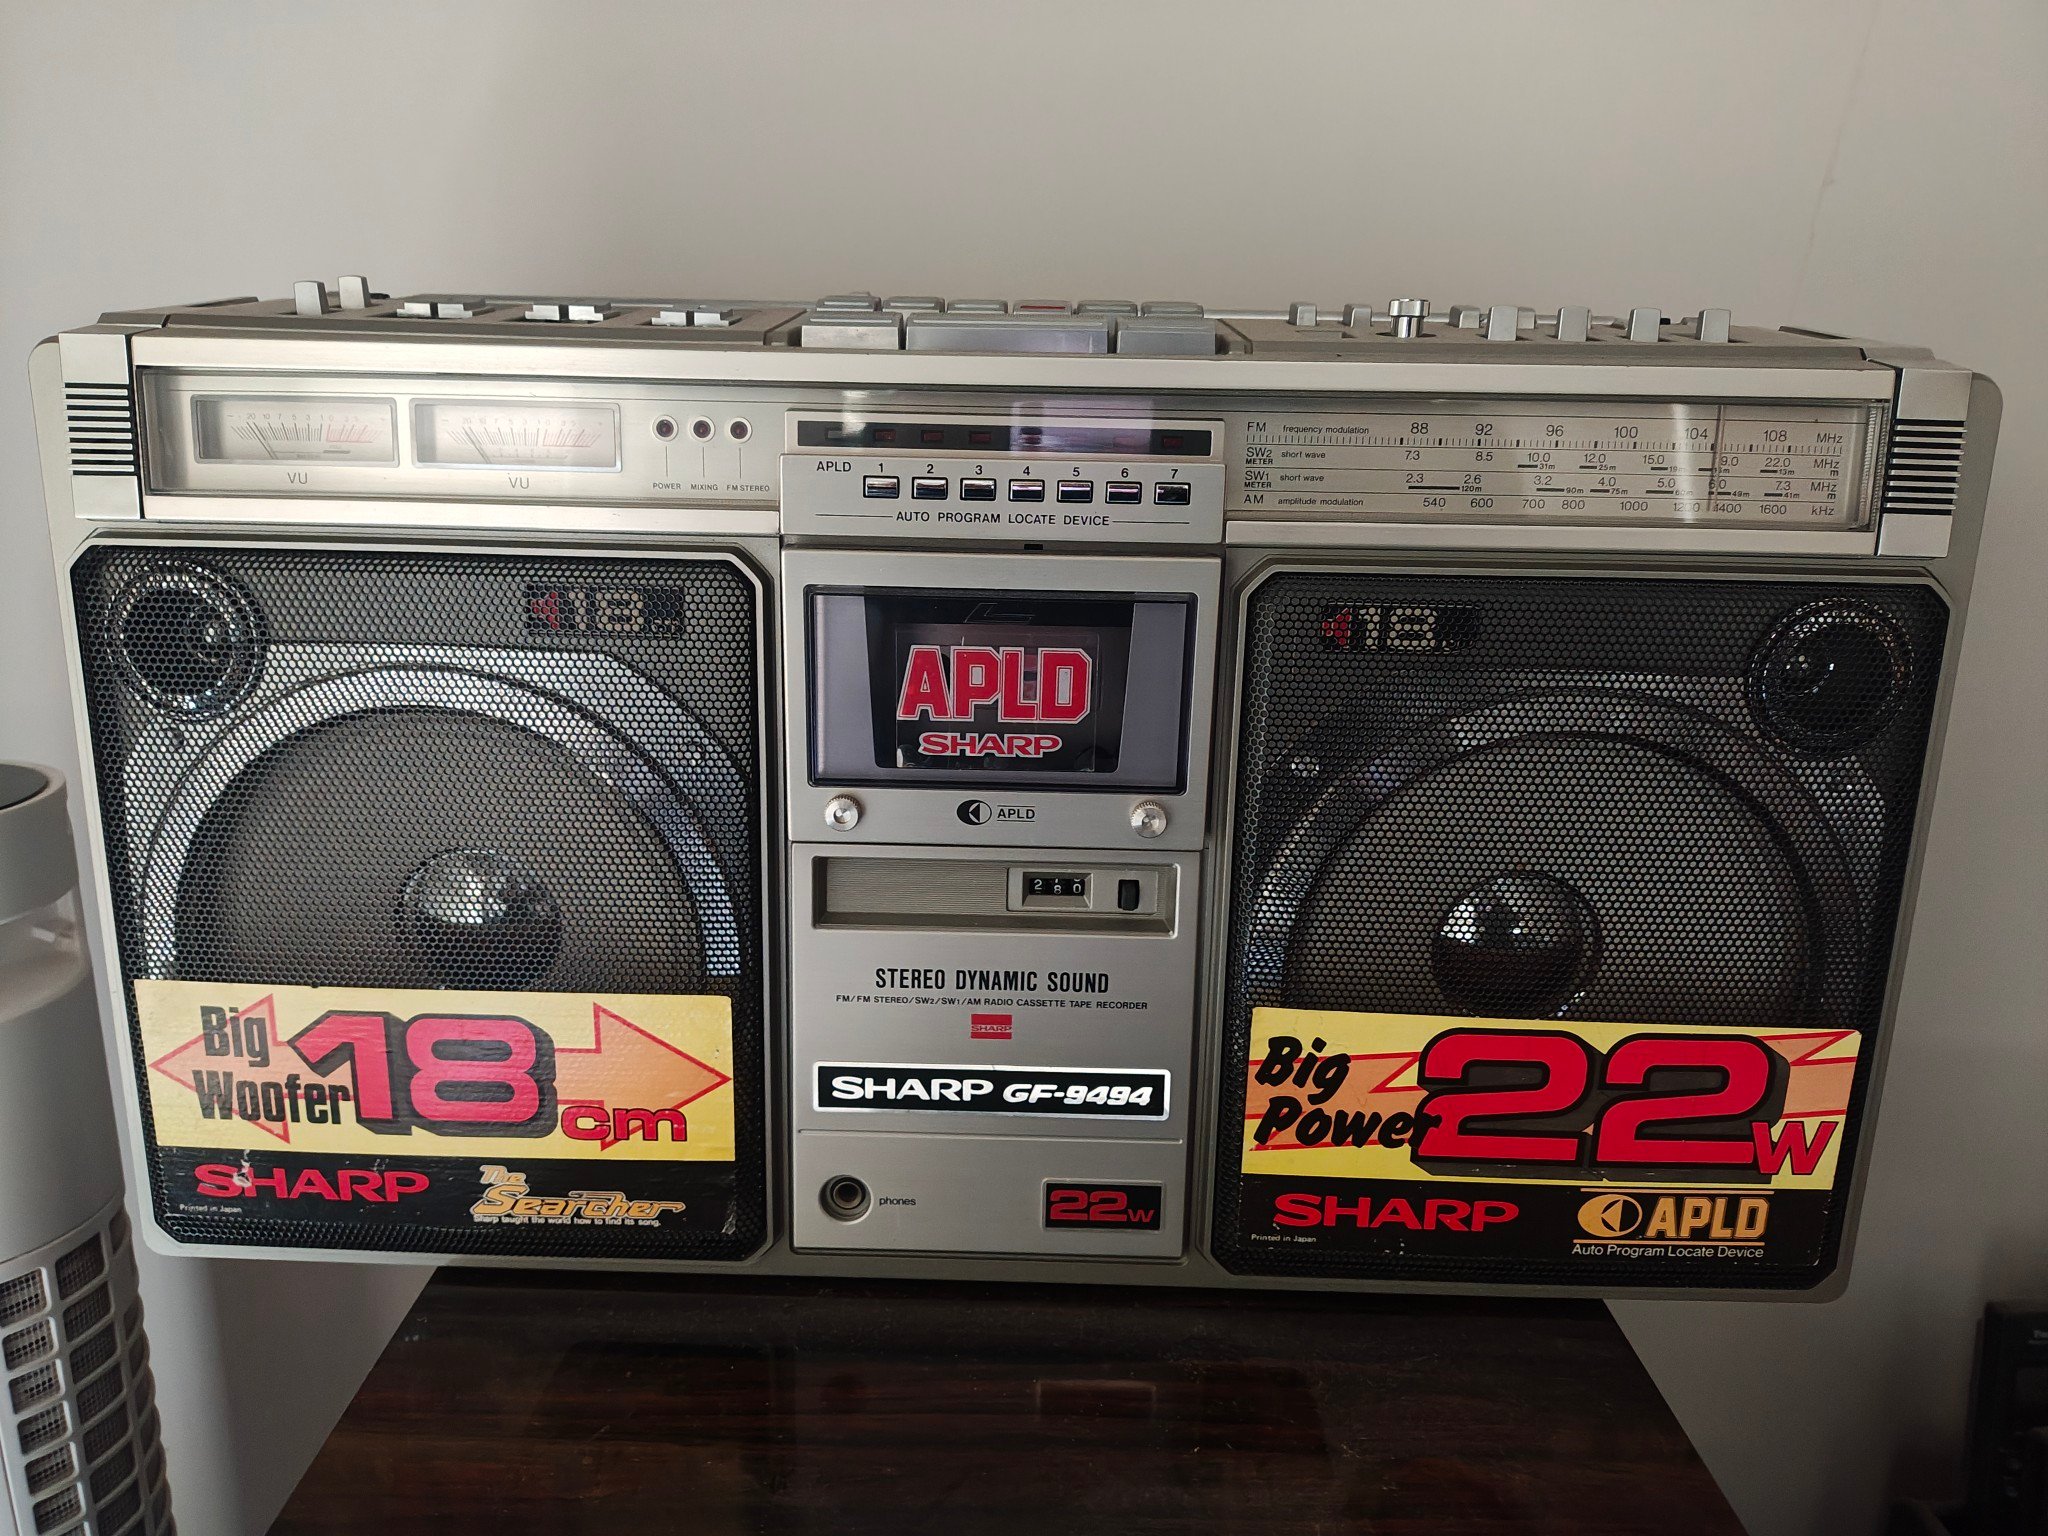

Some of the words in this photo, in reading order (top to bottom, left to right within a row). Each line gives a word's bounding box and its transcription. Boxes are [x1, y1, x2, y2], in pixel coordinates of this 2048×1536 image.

[1247, 422, 1266, 432] FM
[1282, 424, 1322, 434] frequency
[1326, 426, 1369, 434] modulation
[1411, 422, 1428, 434] 88
[1475, 424, 1493, 435] 92
[1546, 425, 1564, 437] 96
[1614, 426, 1638, 438] 100
[1685, 428, 1708, 440] 104
[1764, 430, 1787, 442] 108
[1816, 433, 1843, 444] MHz
[816, 460, 852, 473] APLD
[1281, 450, 1300, 458] short
[1405, 450, 1420, 461] 7.3
[1475, 451, 1493, 462] 8.5
[1527, 452, 1550, 462] 10.0
[1584, 453, 1606, 464] 12.0
[1643, 454, 1664, 464] 15.0
[1764, 457, 1790, 468] 22.0
[1813, 459, 1840, 469] MHz
[287, 472, 309, 485] VU
[878, 464, 884, 473] 1
[926, 465, 934, 474] 2
[975, 465, 983, 475] 3
[1022, 467, 1031, 476] 4
[1072, 468, 1080, 477] 5
[1121, 468, 1129, 478] 6
[1171, 469, 1179, 479] 7
[508, 476, 530, 489] VU
[1280, 474, 1300, 482] short
[1406, 473, 1424, 484] 2.3
[1464, 474, 1482, 485] 2.6
[1534, 475, 1552, 485] 3.2
[1598, 477, 1616, 486] 4.0
[1657, 478, 1675, 488] 5.0
[1776, 481, 1791, 490] 7.3
[1810, 482, 1837, 492] MHz
[1244, 495, 1264, 504] AM
[1278, 498, 1316, 506] amplitude
[1320, 498, 1364, 506] modulation
[1423, 498, 1446, 508] 540
[1470, 498, 1493, 508] 600
[1522, 499, 1545, 509] 700
[1562, 499, 1585, 509] 800
[1620, 501, 1648, 511] 1000
[1760, 505, 1787, 514] 1600
[1811, 506, 1834, 515] kHz
[896, 512, 930, 523] AUTO
[938, 513, 1000, 524] PROGRAM
[1008, 514, 1056, 525] LOCATE
[1063, 515, 1110, 526] DEVICE
[896, 644, 1092, 724] APLD
[918, 732, 1062, 757] SHARP
[997, 808, 1035, 819] APLD
[875, 968, 945, 989] STEREO
[956, 970, 1037, 992] DYNAMIC
[1047, 972, 1109, 993] SOUND
[984, 998, 1013, 1006] RADIO
[1016, 999, 1066, 1007] CASSETTE
[200, 1005, 266, 1068] Big
[1255, 1035, 1350, 1104] Big
[194, 1070, 350, 1124] Woofer
[832, 1077, 994, 1101] SHARP
[1002, 1083, 1153, 1106] GF-9494
[1253, 1096, 1444, 1149] Power
[195, 1163, 430, 1202] SHARP
[480, 1165, 526, 1184] The
[179, 1204, 208, 1212] Printed
[220, 1205, 242, 1214] Japan
[470, 1184, 686, 1218] Searcher
[879, 1196, 916, 1206] phones
[473, 1215, 499, 1224] Sharp
[501, 1216, 528, 1225] taught
[531, 1216, 545, 1224] the
[638, 1219, 661, 1227] song.
[1273, 1194, 1519, 1232] SHARP
[1645, 1196, 1770, 1239] APLD
[1251, 1233, 1281, 1241] Printed
[1293, 1235, 1317, 1243] Japan
[1572, 1242, 1603, 1256] Auto
[1607, 1244, 1664, 1259] Program
[1668, 1245, 1713, 1258] Locate
[1717, 1246, 1764, 1258] Device
